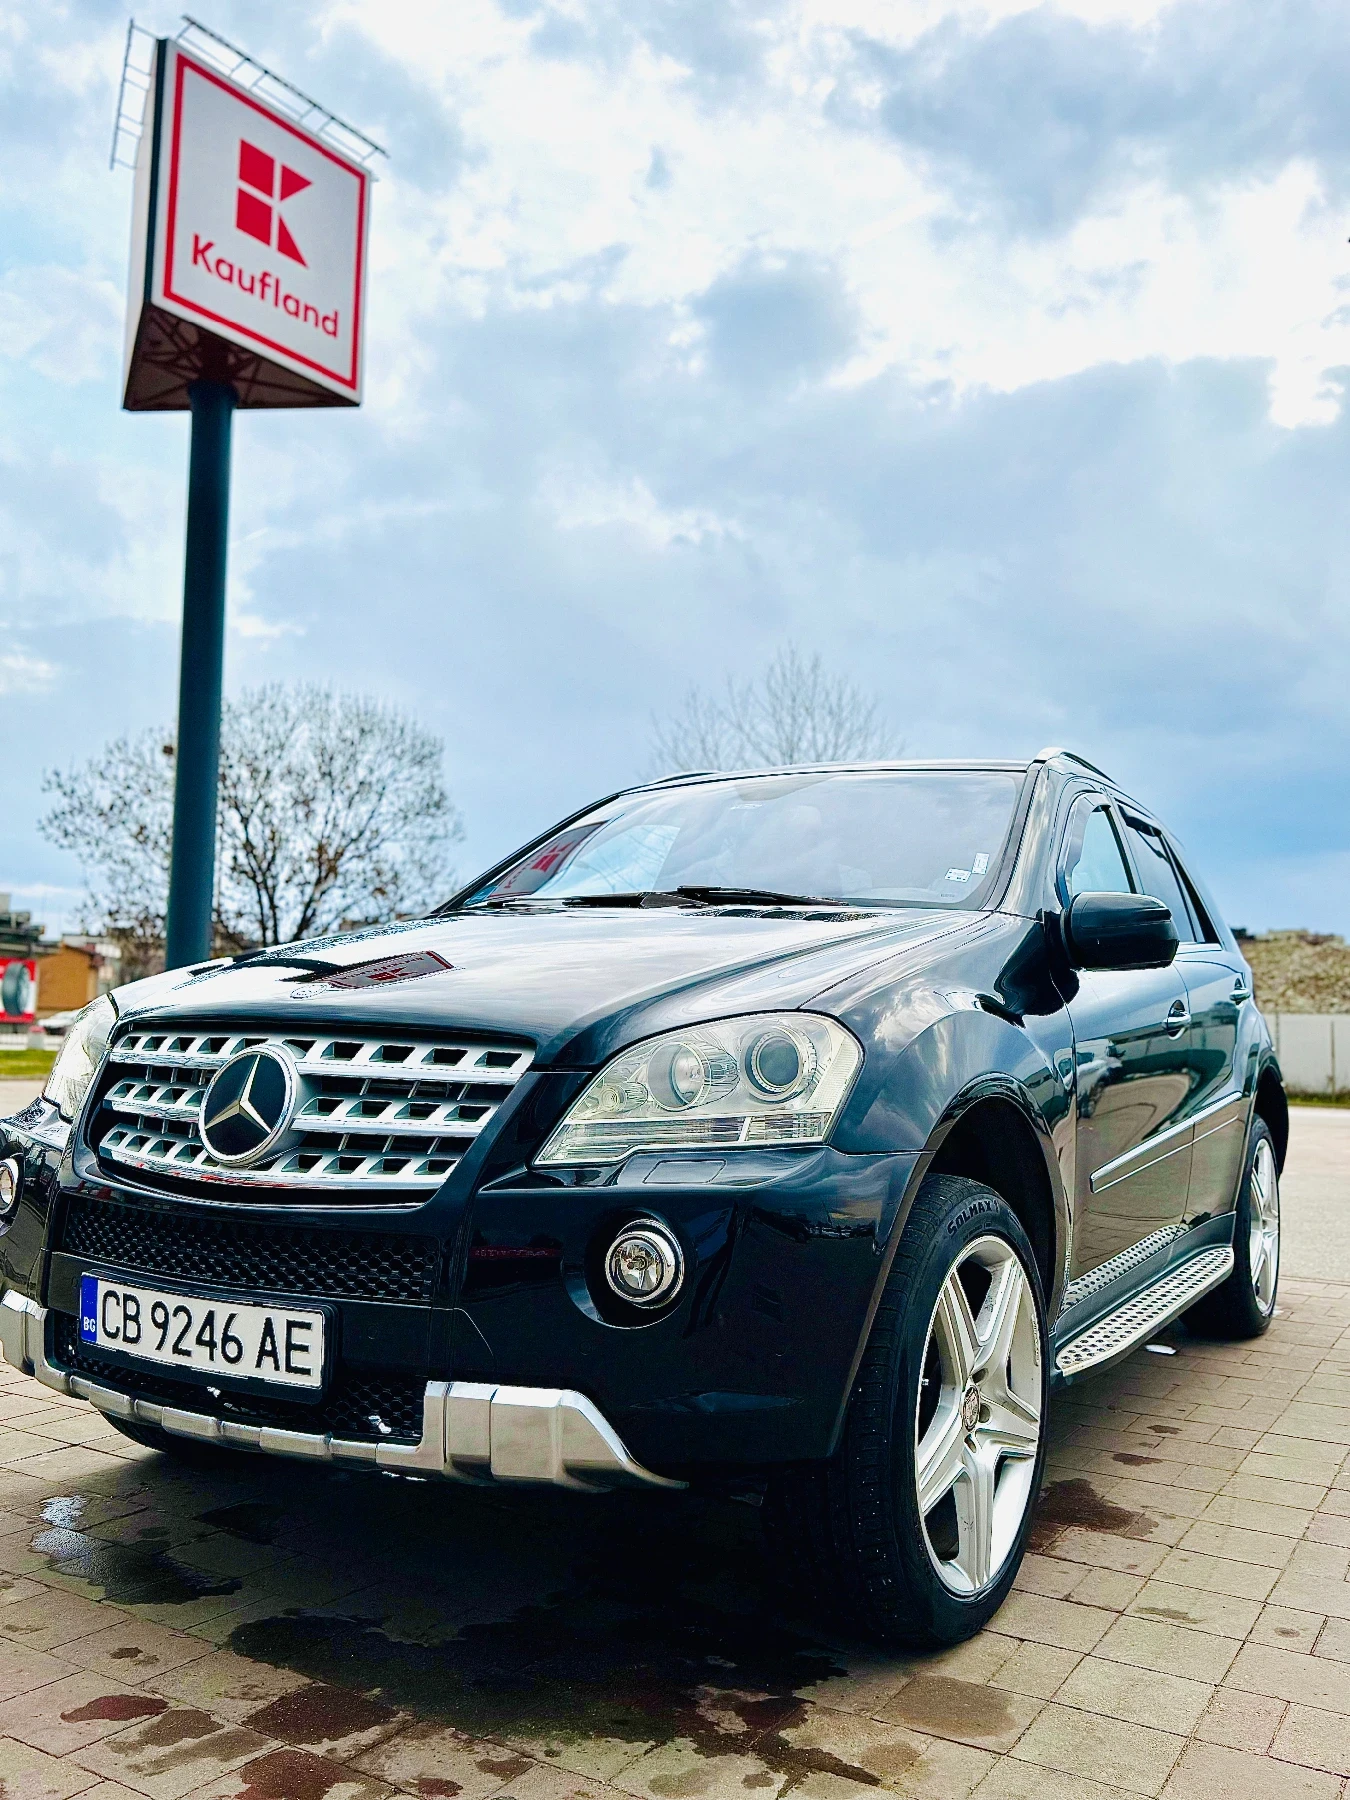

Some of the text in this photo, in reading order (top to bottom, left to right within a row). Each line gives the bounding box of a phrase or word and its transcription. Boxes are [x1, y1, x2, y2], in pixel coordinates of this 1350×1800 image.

[192, 232, 339, 338] Kaufland
[947, 1201, 992, 1238] SOLMAX
[83, 1316, 96, 1333] BG
[101, 1289, 313, 1376] CB 9246 AE
